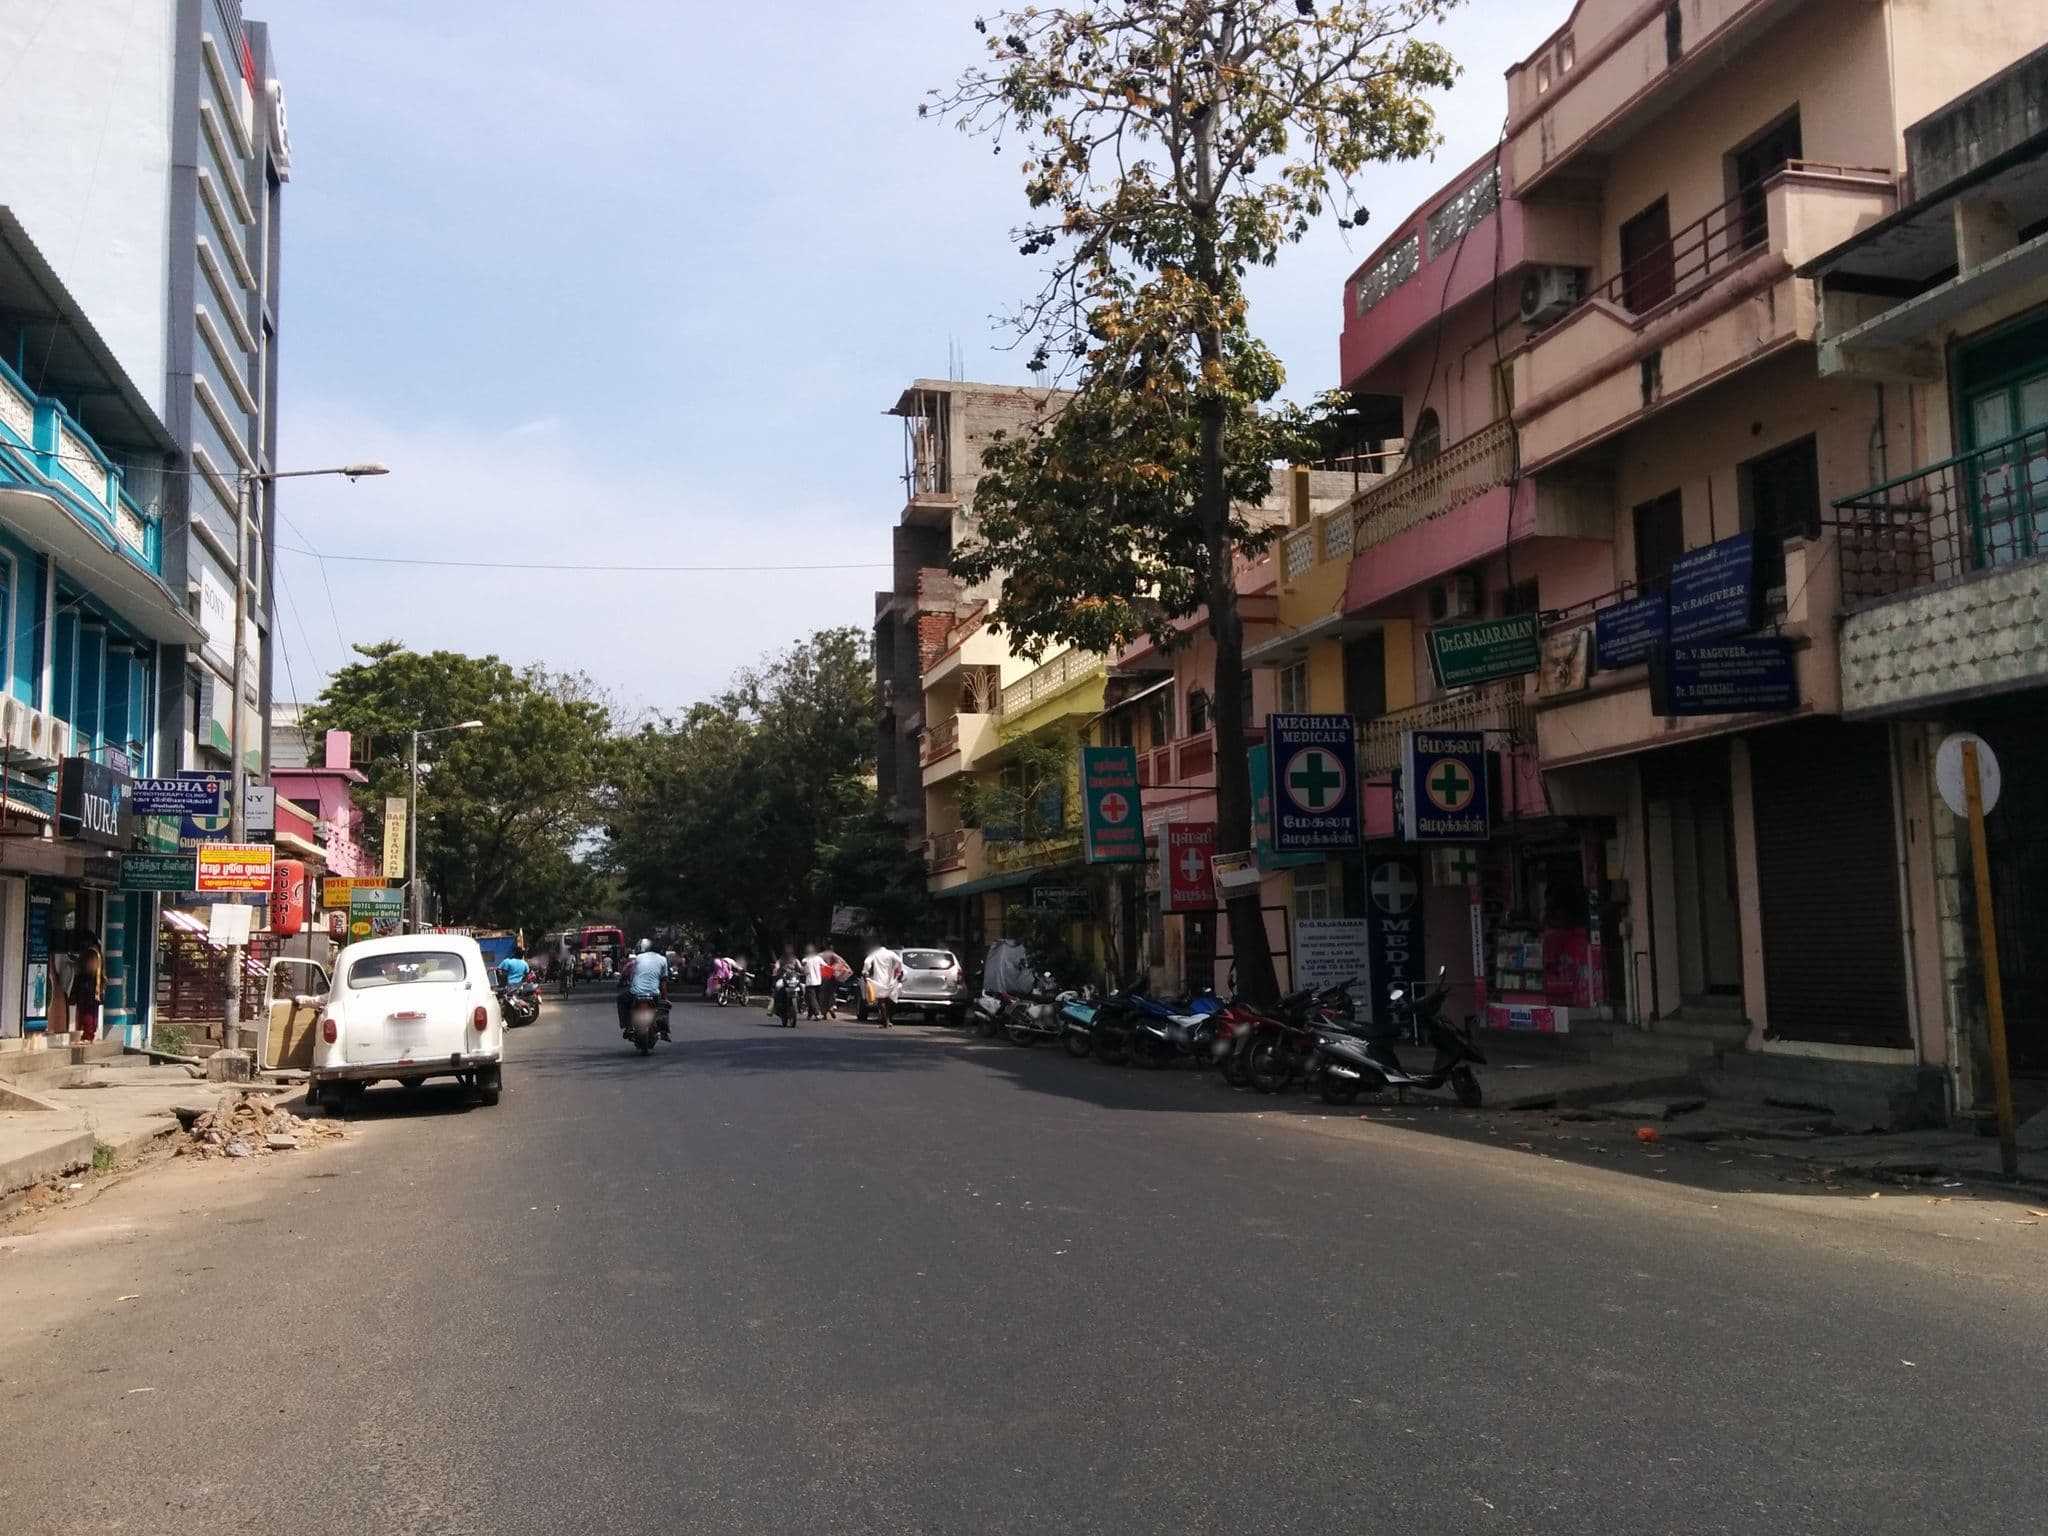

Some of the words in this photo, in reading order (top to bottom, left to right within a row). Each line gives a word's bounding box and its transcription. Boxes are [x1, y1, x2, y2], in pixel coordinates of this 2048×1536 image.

[204, 583, 225, 621] SONY
[1439, 620, 1533, 652] Dr.G.RAJARAMAN
[1277, 717, 1350, 729] MEGHALA
[1283, 731, 1346, 743] MEDICALS
[1418, 735, 1481, 753] மேகலா
[133, 781, 204, 792] MADHA
[82, 792, 119, 836] NURA
[1283, 815, 1352, 828] மேகலா
[325, 880, 350, 888] HOTEL
[280, 868, 289, 925] SUSHI
